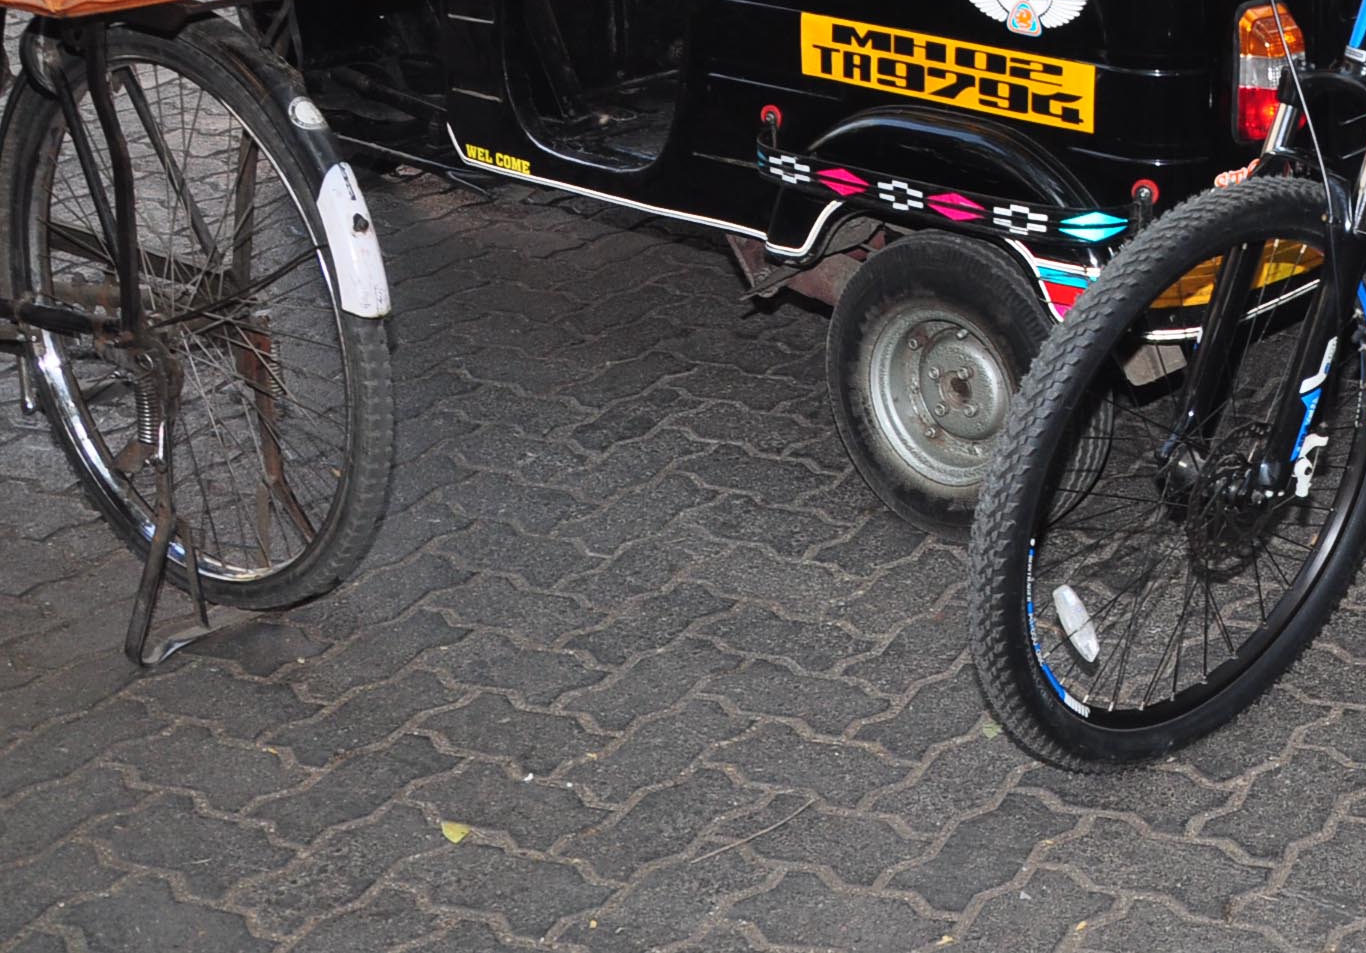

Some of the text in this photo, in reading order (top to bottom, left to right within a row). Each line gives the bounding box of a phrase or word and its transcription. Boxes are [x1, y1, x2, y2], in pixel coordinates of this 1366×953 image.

[811, 44, 1086, 126] TA9794
[831, 22, 1064, 88] MH02
[465, 143, 532, 176] WEL COME
